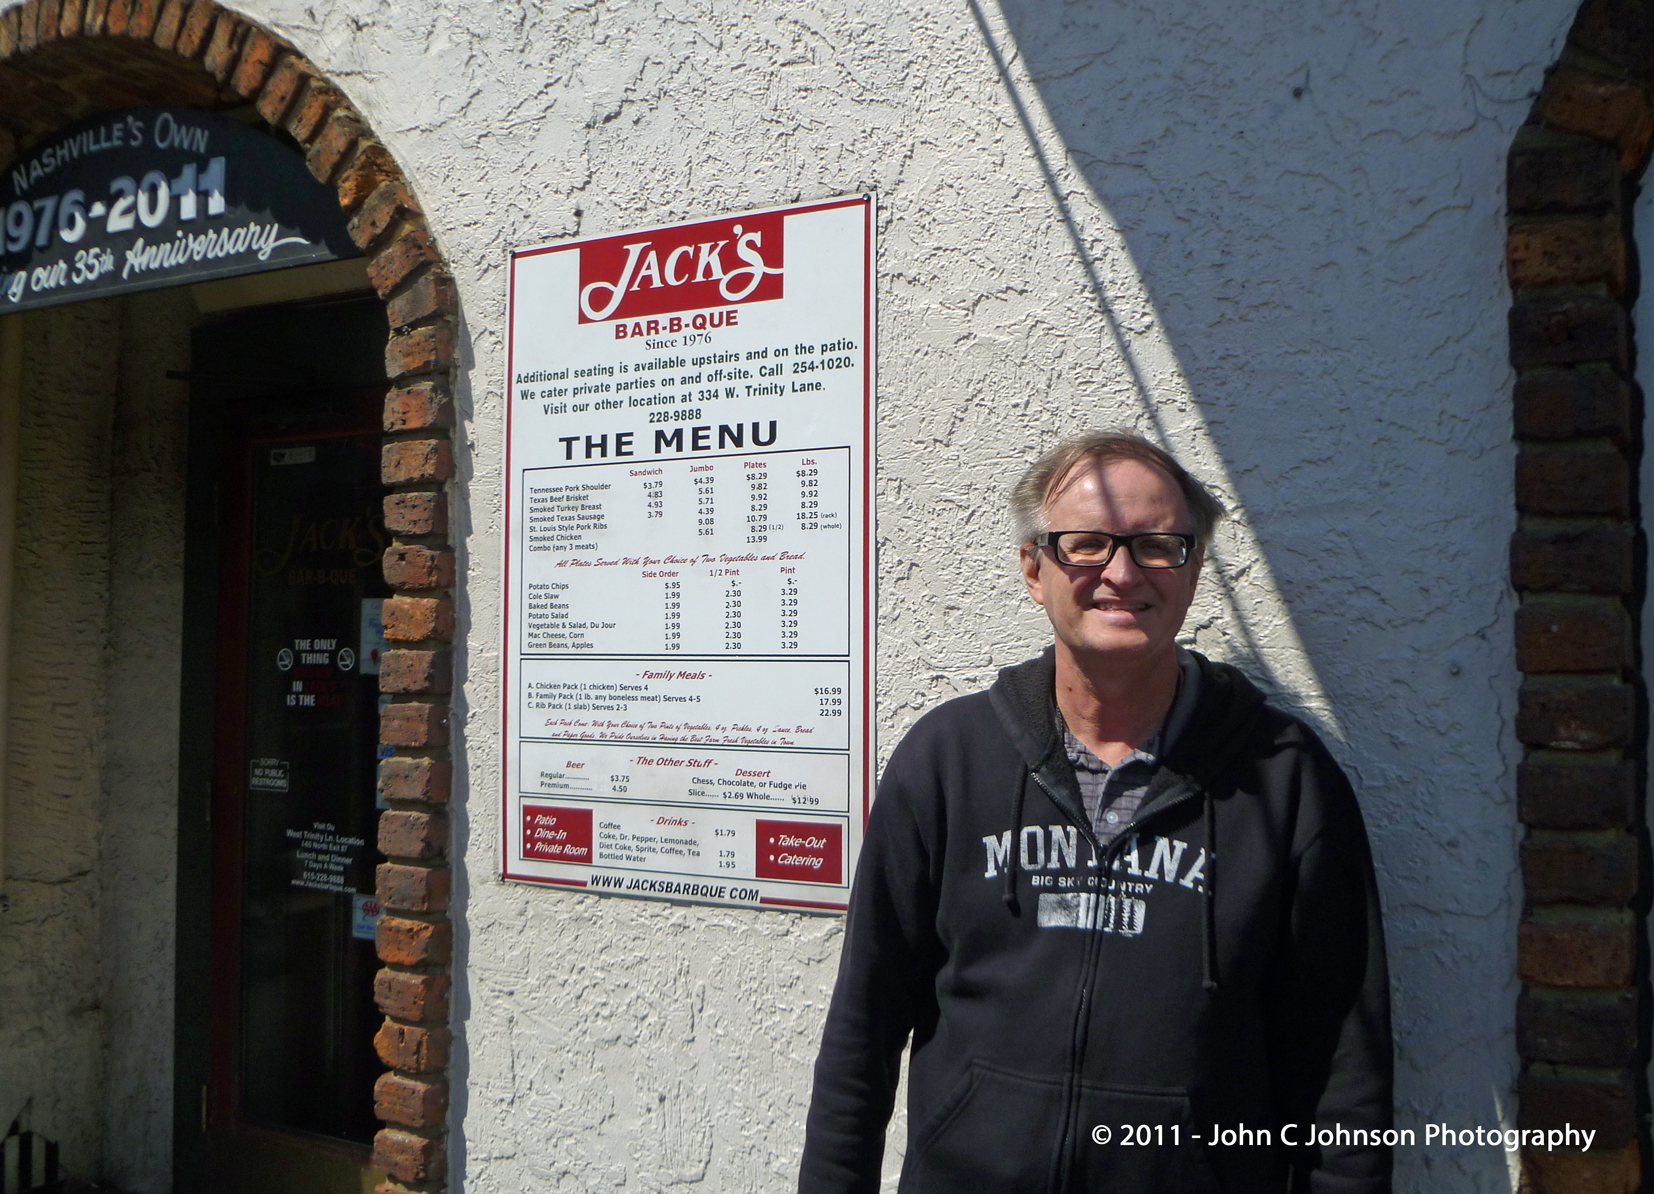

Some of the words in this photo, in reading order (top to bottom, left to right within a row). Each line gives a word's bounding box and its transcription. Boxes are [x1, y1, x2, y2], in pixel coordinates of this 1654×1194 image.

[31, 259, 67, 292] our
[72, 247, 115, 284] 35th
[123, 222, 309, 279] Anniversary
[580, 224, 784, 321] JACK'S
[615, 310, 739, 340] BAR-B-QUE
[645, 336, 678, 352] Since
[682, 331, 712, 349] 1976
[516, 368, 569, 384] Additional
[574, 364, 614, 379] seating
[619, 362, 629, 374] is
[634, 356, 686, 372] available
[692, 351, 740, 368] upstairs
[746, 347, 768, 361] and
[774, 346, 789, 357] on
[795, 343, 815, 355] the
[821, 338, 858, 355] patio.
[520, 389, 536, 400] We
[540, 387, 568, 399] cater
[573, 382, 611, 398] private
[616, 377, 656, 395] parties
[661, 376, 675, 387] on
[680, 372, 701, 385] and
[707, 369, 754, 383] off-site.
[759, 363, 783, 378] Call
[792, 356, 855, 374] 254-1020.
[543, 402, 567, 416] Visit
[572, 402, 589, 413] our
[594, 399, 623, 411] other
[628, 393, 675, 408] location
[681, 391, 692, 403] at
[698, 388, 719, 402] 334
[725, 387, 739, 399] W.
[745, 383, 785, 398] Trinity
[792, 380, 826, 393] Lane.
[649, 408, 702, 424] 228-9888
[558, 432, 634, 461] THE
[654, 420, 777, 454] MENU
[629, 468, 663, 477] Sandwich
[689, 464, 714, 473] Jumbo
[744, 461, 767, 469] Plates
[801, 458, 818, 466] Lbs.
[530, 486, 563, 494] Tennessee
[565, 485, 580, 493] Pork
[581, 483, 612, 492] Shoulder
[643, 481, 663, 490] $3.79
[693, 476, 715, 485] $4.39
[746, 472, 768, 482] $8.29
[796, 468, 818, 478] $8.29
[566, 494, 589, 502] Brisket
[647, 491, 663, 499] 4.83
[698, 487, 714, 495] 5.61
[751, 483, 768, 491] 9.82
[801, 479, 818, 488] 9.82
[529, 506, 555, 514] Smoked
[556, 505, 579, 513] Turkey
[580, 503, 602, 511] Breast
[647, 501, 663, 509] 4.93
[698, 497, 714, 505] 5.71
[751, 493, 768, 502] 9.92
[801, 490, 818, 498] 9.92
[529, 515, 555, 523] Smoked
[556, 514, 576, 522] Texas
[577, 513, 605, 522] Sausage
[647, 511, 663, 519] 3.79
[698, 508, 715, 516] 4.39
[751, 504, 768, 512] 8.29
[801, 501, 818, 509] 8.29
[529, 525, 538, 533] St.
[539, 525, 556, 533] Louis
[558, 524, 575, 533] Style
[576, 523, 591, 531] Pork
[593, 522, 608, 530] Ribs
[698, 518, 715, 526] 9.08
[746, 514, 768, 523] 10.79
[796, 512, 818, 520] 18.25
[698, 528, 714, 536] 5.61
[751, 525, 768, 533] 8.29
[801, 522, 818, 531] 8.29
[529, 544, 551, 552] Combo
[553, 544, 567, 553] (any
[569, 543, 574, 551] 3
[575, 542, 598, 551] meats)
[746, 535, 768, 544] 13.99
[642, 570, 657, 578] Side
[658, 570, 679, 578] Order
[709, 569, 723, 577] 1/2
[724, 568, 740, 576] Pint
[780, 566, 796, 574] Pint
[294, 639, 311, 651] THE
[314, 639, 337, 651] ONLY
[301, 653, 329, 664] THING
[642, 670, 675, 681] Family
[676, 670, 706, 681] Meals
[293, 681, 303, 692] IN
[814, 687, 842, 696] $16.99
[287, 695, 296, 706] IS
[298, 695, 316, 706] THE
[819, 698, 842, 706] 17.99
[819, 709, 842, 717] 22.99
[380, 747, 395, 758] VIS
[259, 758, 280, 766] SORRY
[566, 761, 585, 769] Beer
[636, 757, 654, 766] The
[656, 757, 684, 767] Other
[686, 758, 714, 768] Stuff
[254, 768, 264, 776] NO
[265, 769, 284, 777] PUBLIC
[735, 768, 771, 778] Dessert
[252, 778, 287, 788] RESTROOMS
[534, 814, 556, 826] Patio
[656, 816, 689, 827] Drinks
[534, 828, 567, 840] Dine-In
[778, 834, 826, 848] Take-Out
[534, 841, 562, 853] Private
[564, 844, 588, 856] Room
[778, 853, 823, 868] Catering
[1032, 875, 1053, 886] BIG
